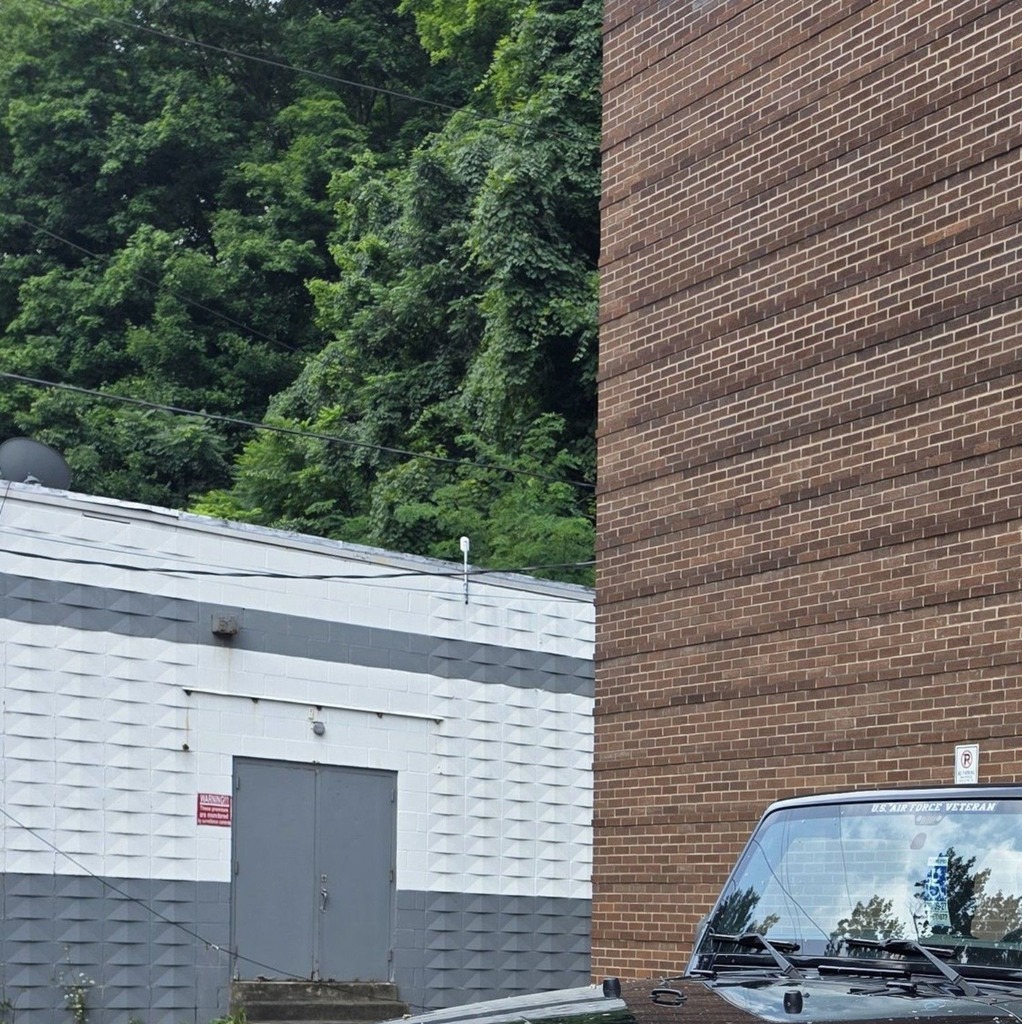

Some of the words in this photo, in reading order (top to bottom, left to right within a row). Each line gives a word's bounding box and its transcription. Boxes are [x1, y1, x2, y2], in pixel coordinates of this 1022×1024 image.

[871, 803, 887, 813] U.S.
[888, 803, 908, 813] AIR
[909, 803, 942, 812] FORCE
[945, 802, 997, 812] VETERAN
